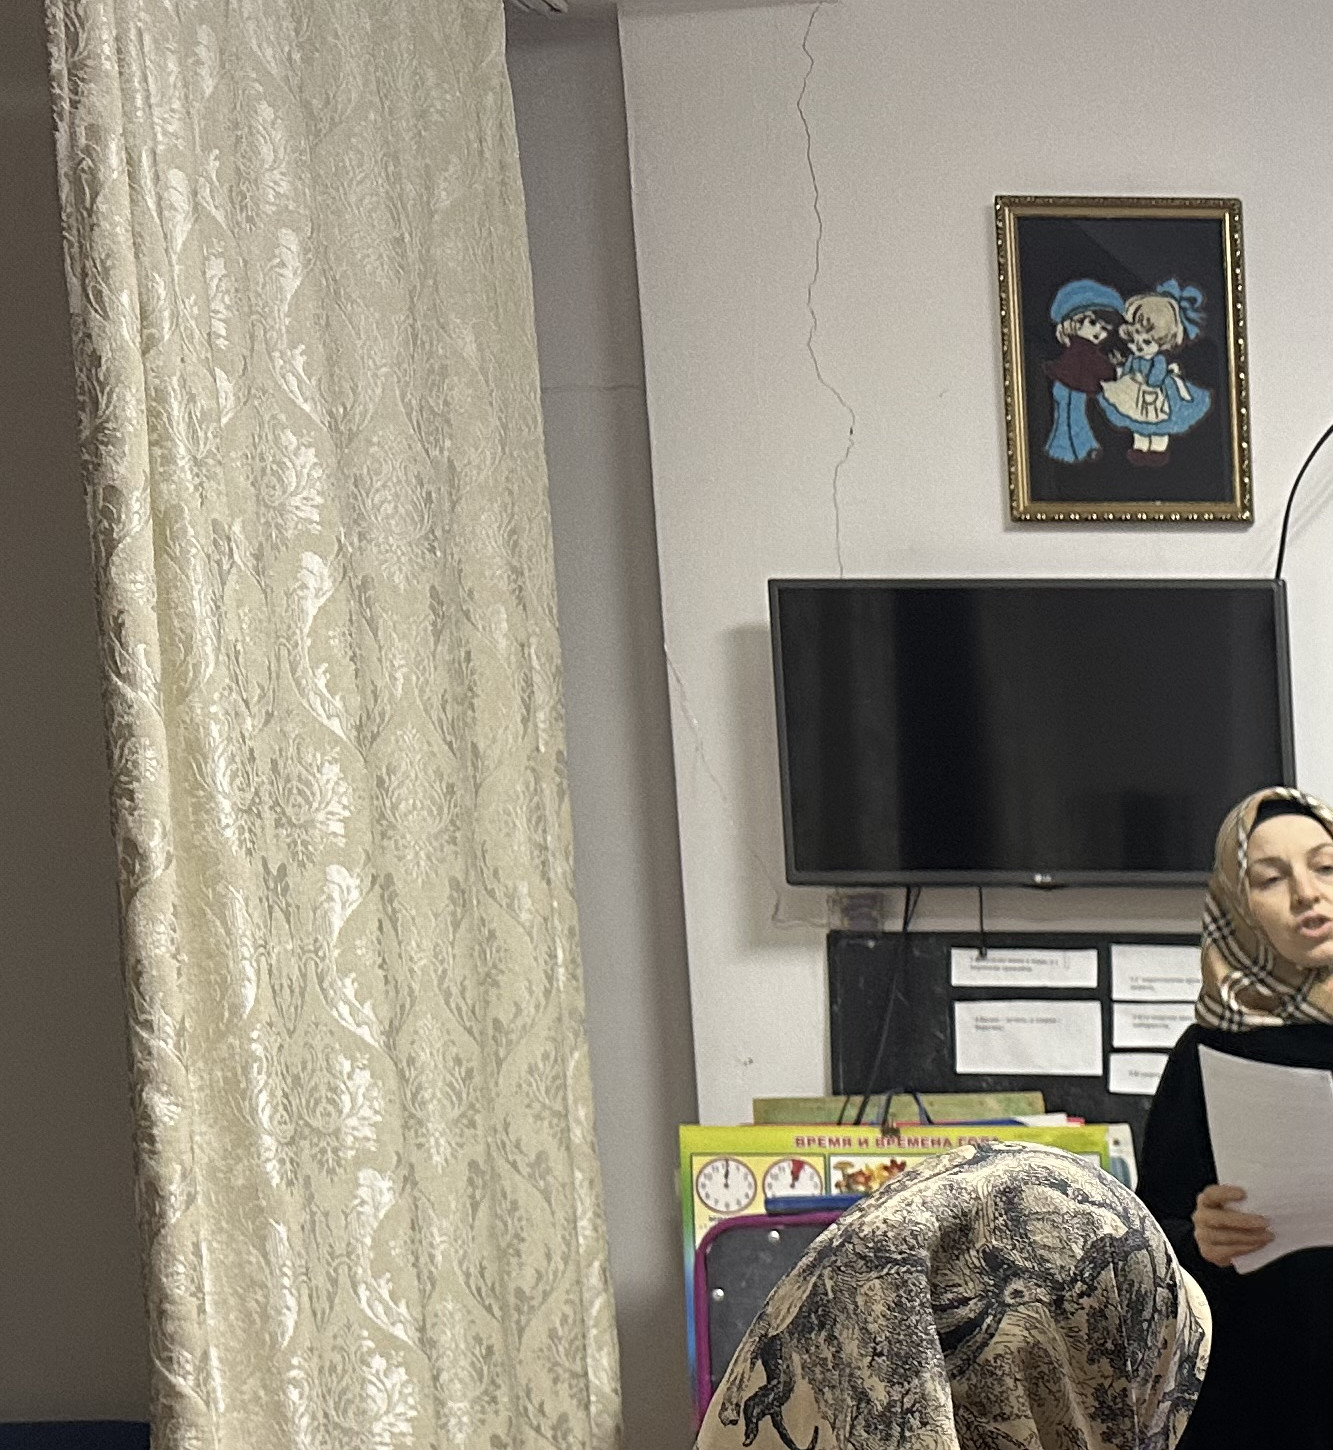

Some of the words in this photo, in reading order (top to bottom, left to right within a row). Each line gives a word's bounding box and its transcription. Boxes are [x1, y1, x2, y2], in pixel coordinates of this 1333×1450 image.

[795, 1135, 852, 1148] ВРЕМЯ
[858, 1135, 870, 1148] И
[875, 1135, 951, 1148] ВРЕМЕНА
